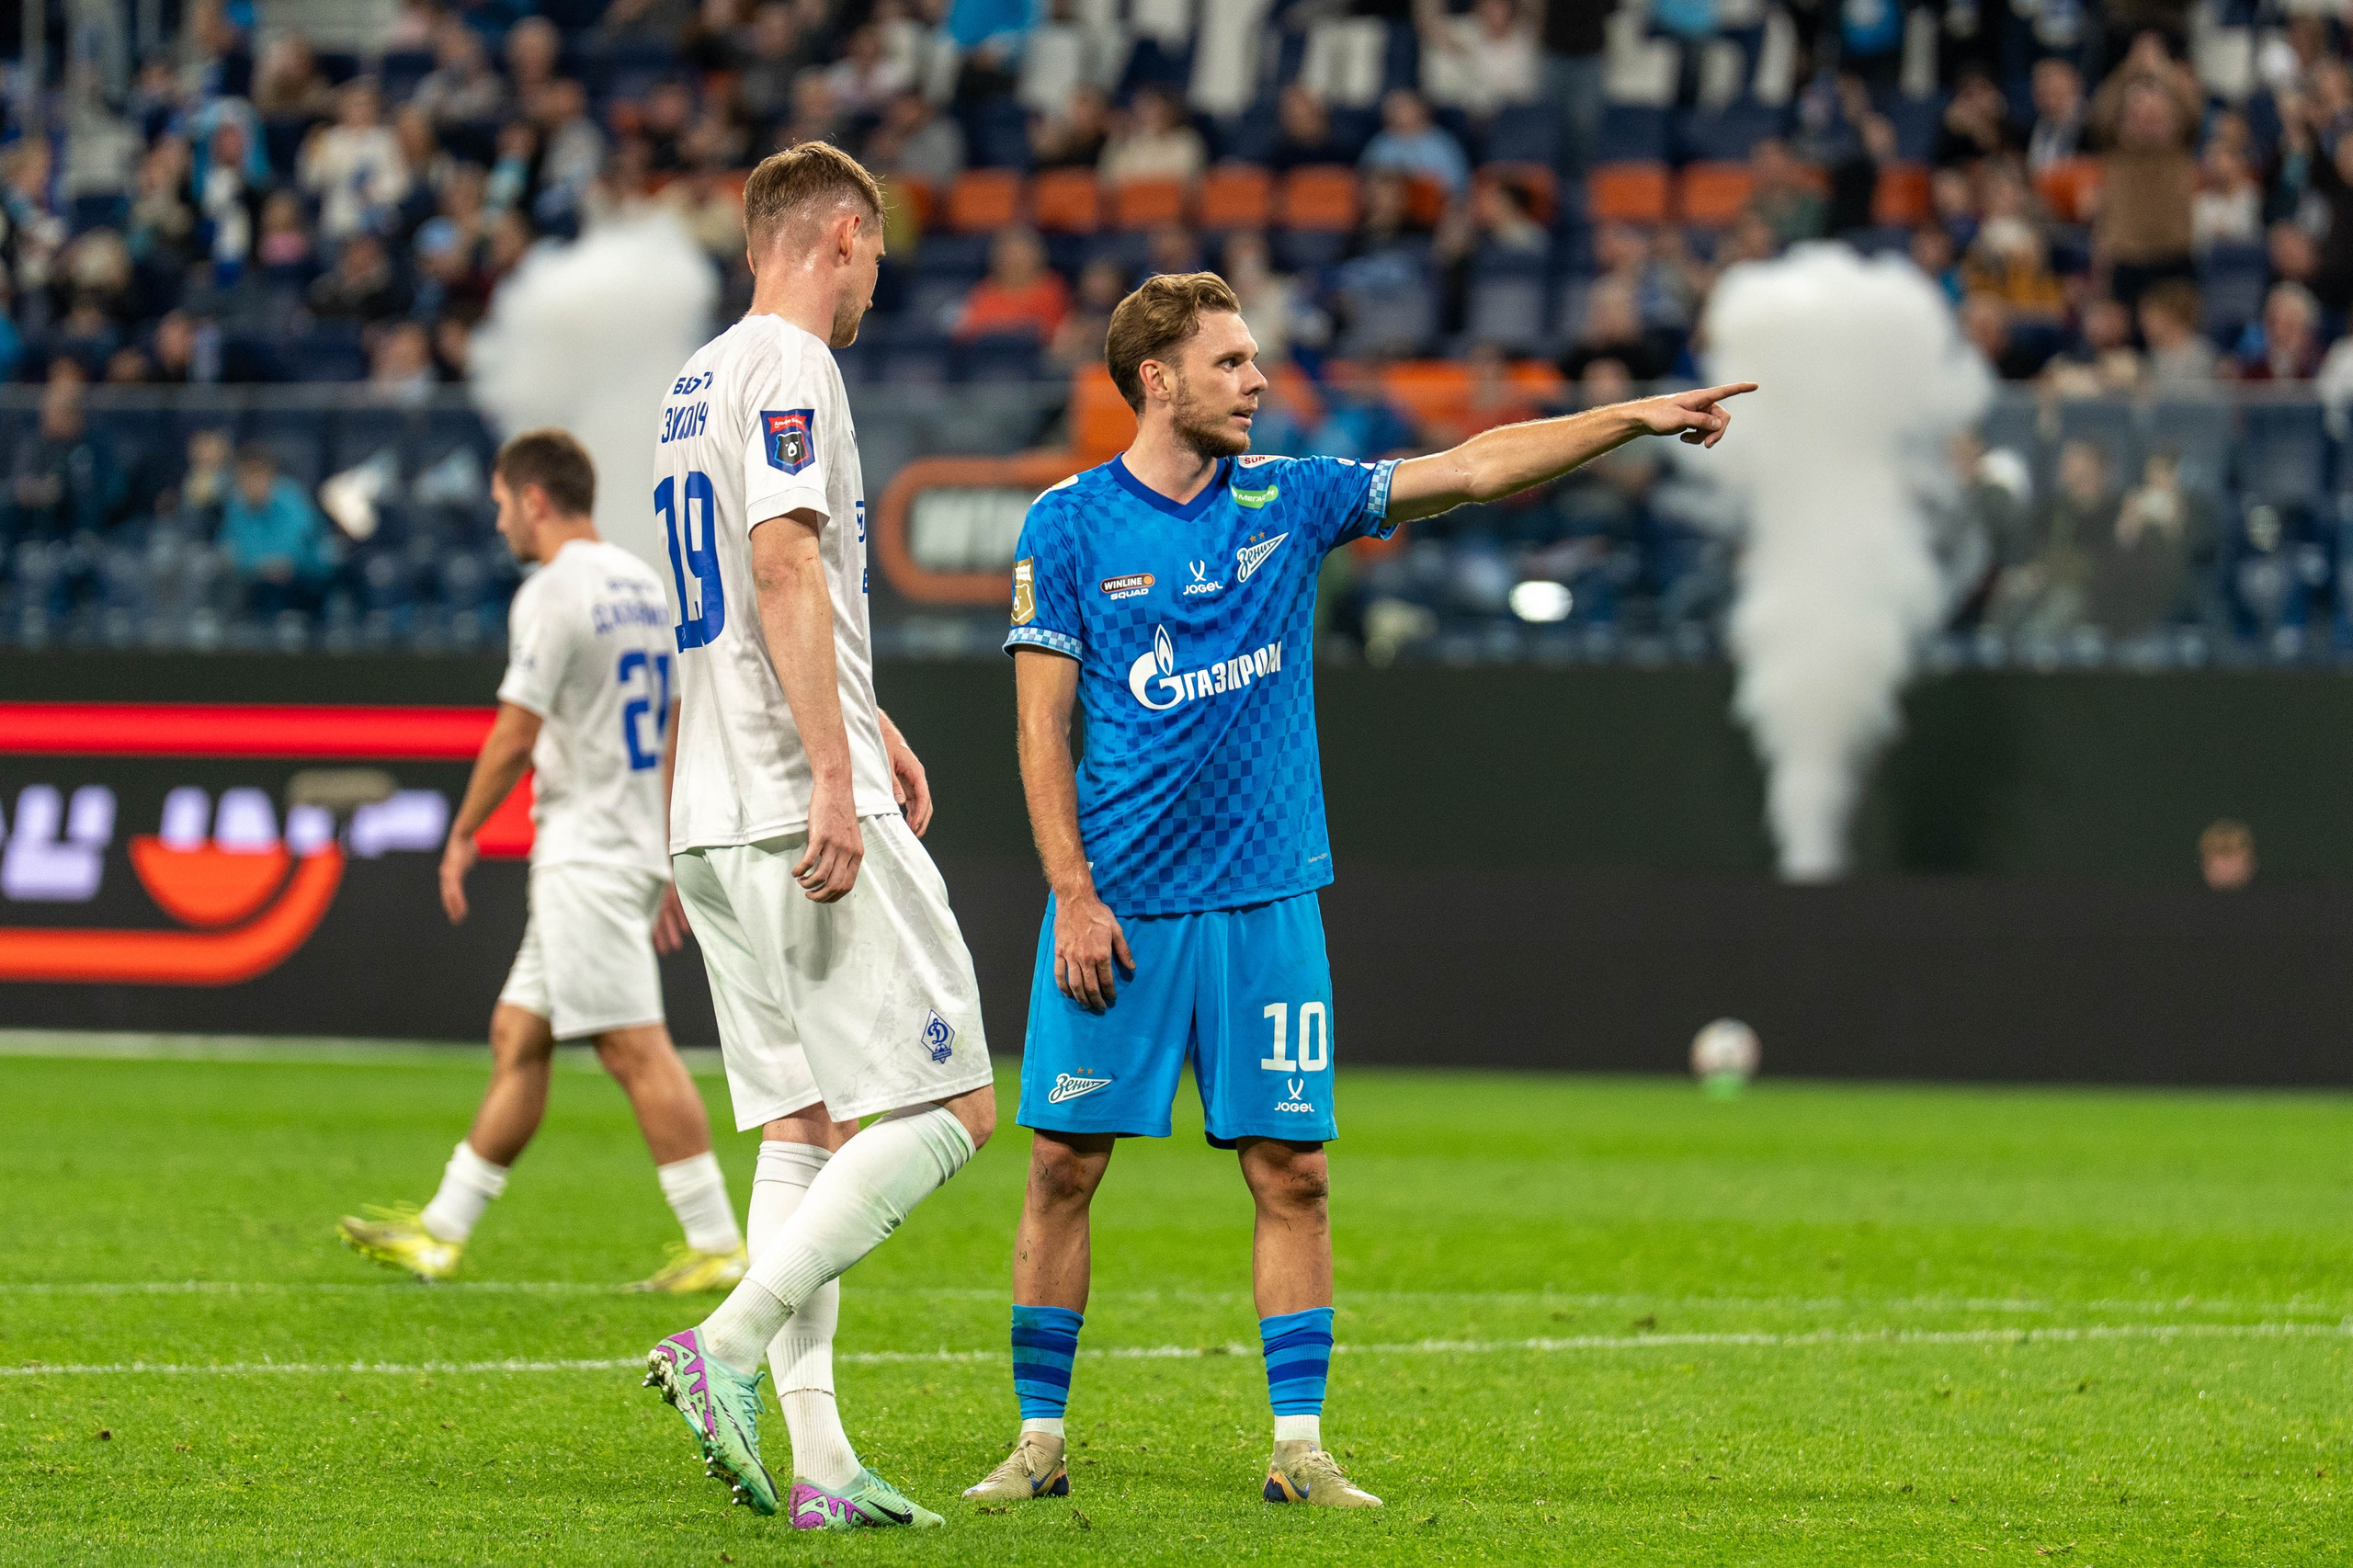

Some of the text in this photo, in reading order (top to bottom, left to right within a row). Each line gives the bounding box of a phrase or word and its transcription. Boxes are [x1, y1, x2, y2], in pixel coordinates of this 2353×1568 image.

[654, 472, 725, 653] 19
[1104, 577, 1142, 591] WINLINE
[1110, 588, 1149, 600] SQUAD
[1183, 640, 1282, 701] ГАЗПРОМ
[1261, 1001, 1328, 1073] 10
